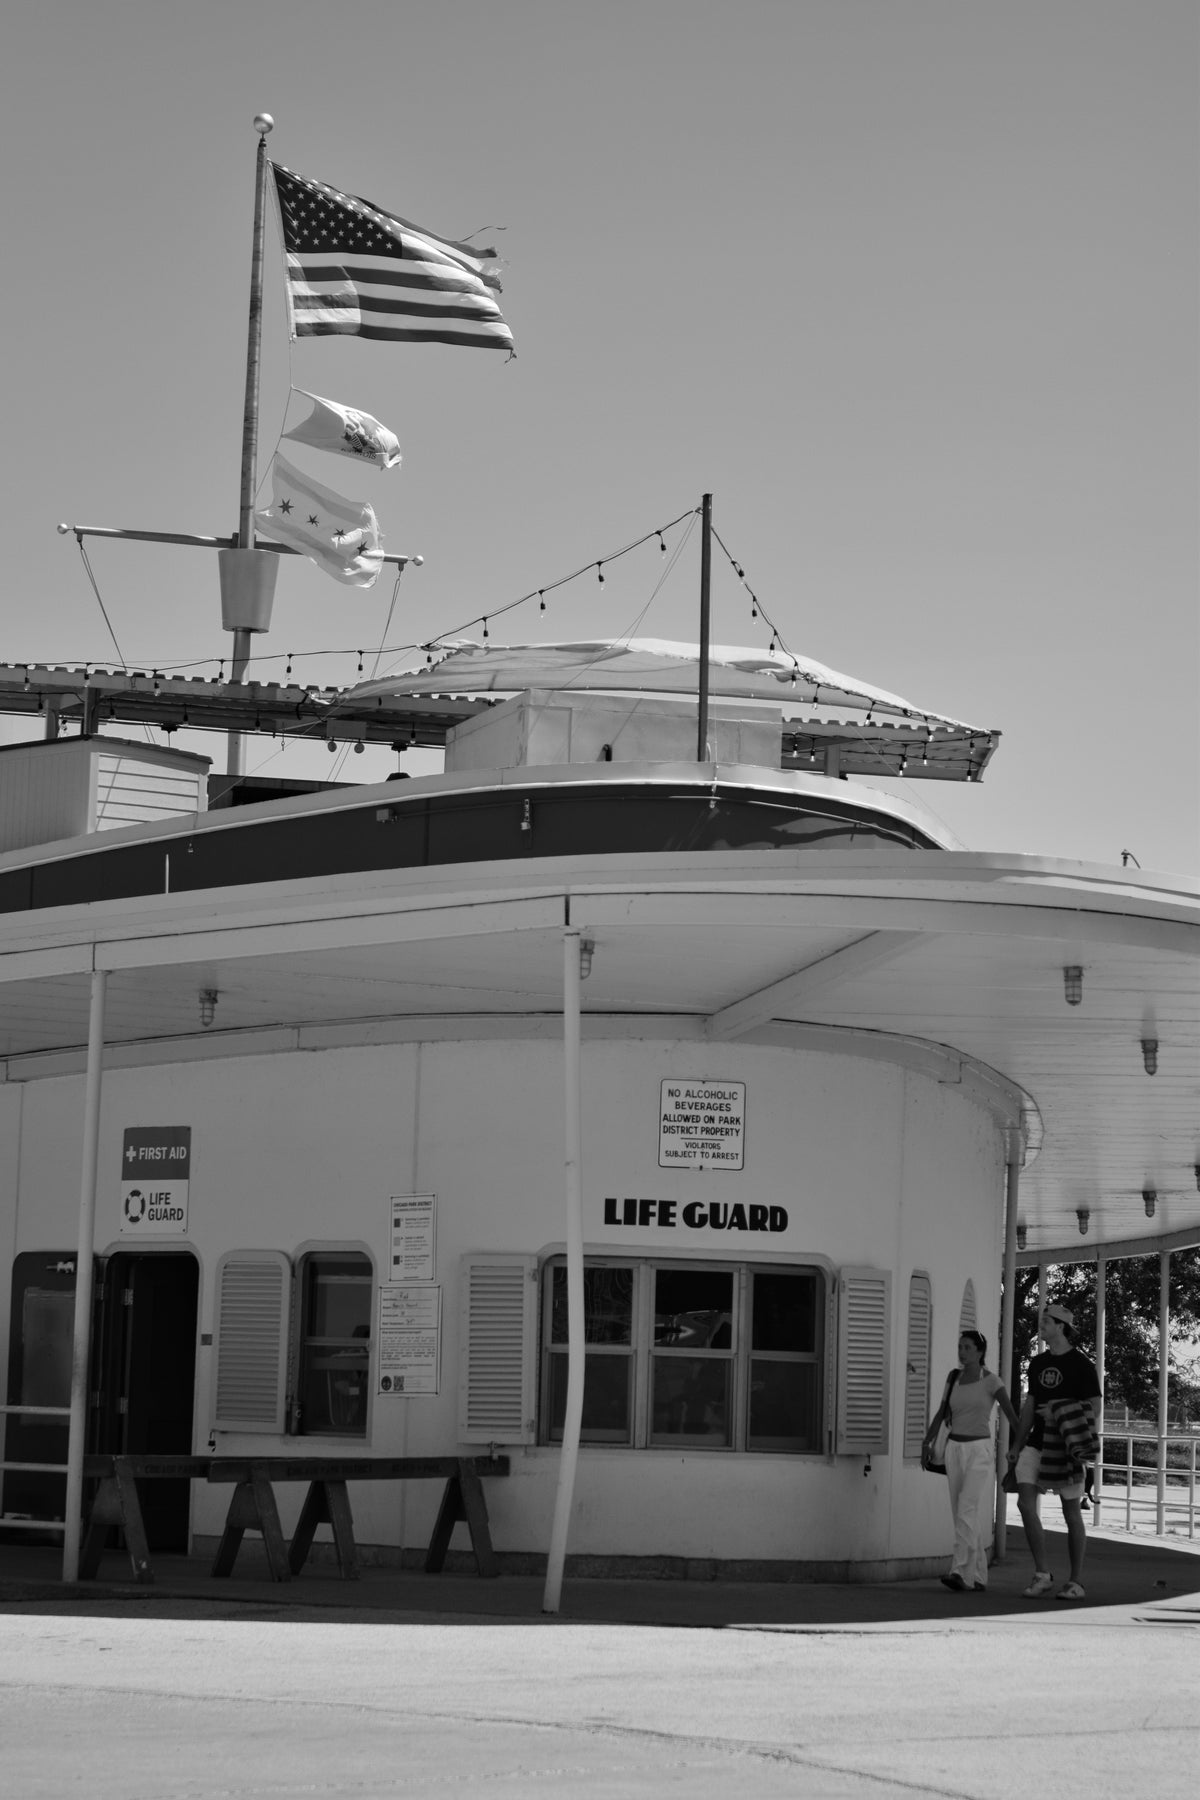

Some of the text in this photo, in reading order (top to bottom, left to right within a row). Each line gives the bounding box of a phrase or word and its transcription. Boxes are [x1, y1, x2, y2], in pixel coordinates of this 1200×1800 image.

[667, 1088, 738, 1101] NO ALCOHOLIC
[675, 1101, 732, 1112] BEVERAGES
[662, 1113, 741, 1125] ALLOWED ON PARK
[662, 1125, 741, 1137] DISTRICT PROPERTY
[685, 1142, 722, 1150] VIOLATORS
[138, 1146, 187, 1160] FIRST AID
[665, 1150, 740, 1160] SUBJECT TO ARREST
[149, 1192, 172, 1205] LIFE
[148, 1208, 184, 1221] GUARD
[604, 1198, 789, 1233] LIFE GUARD
